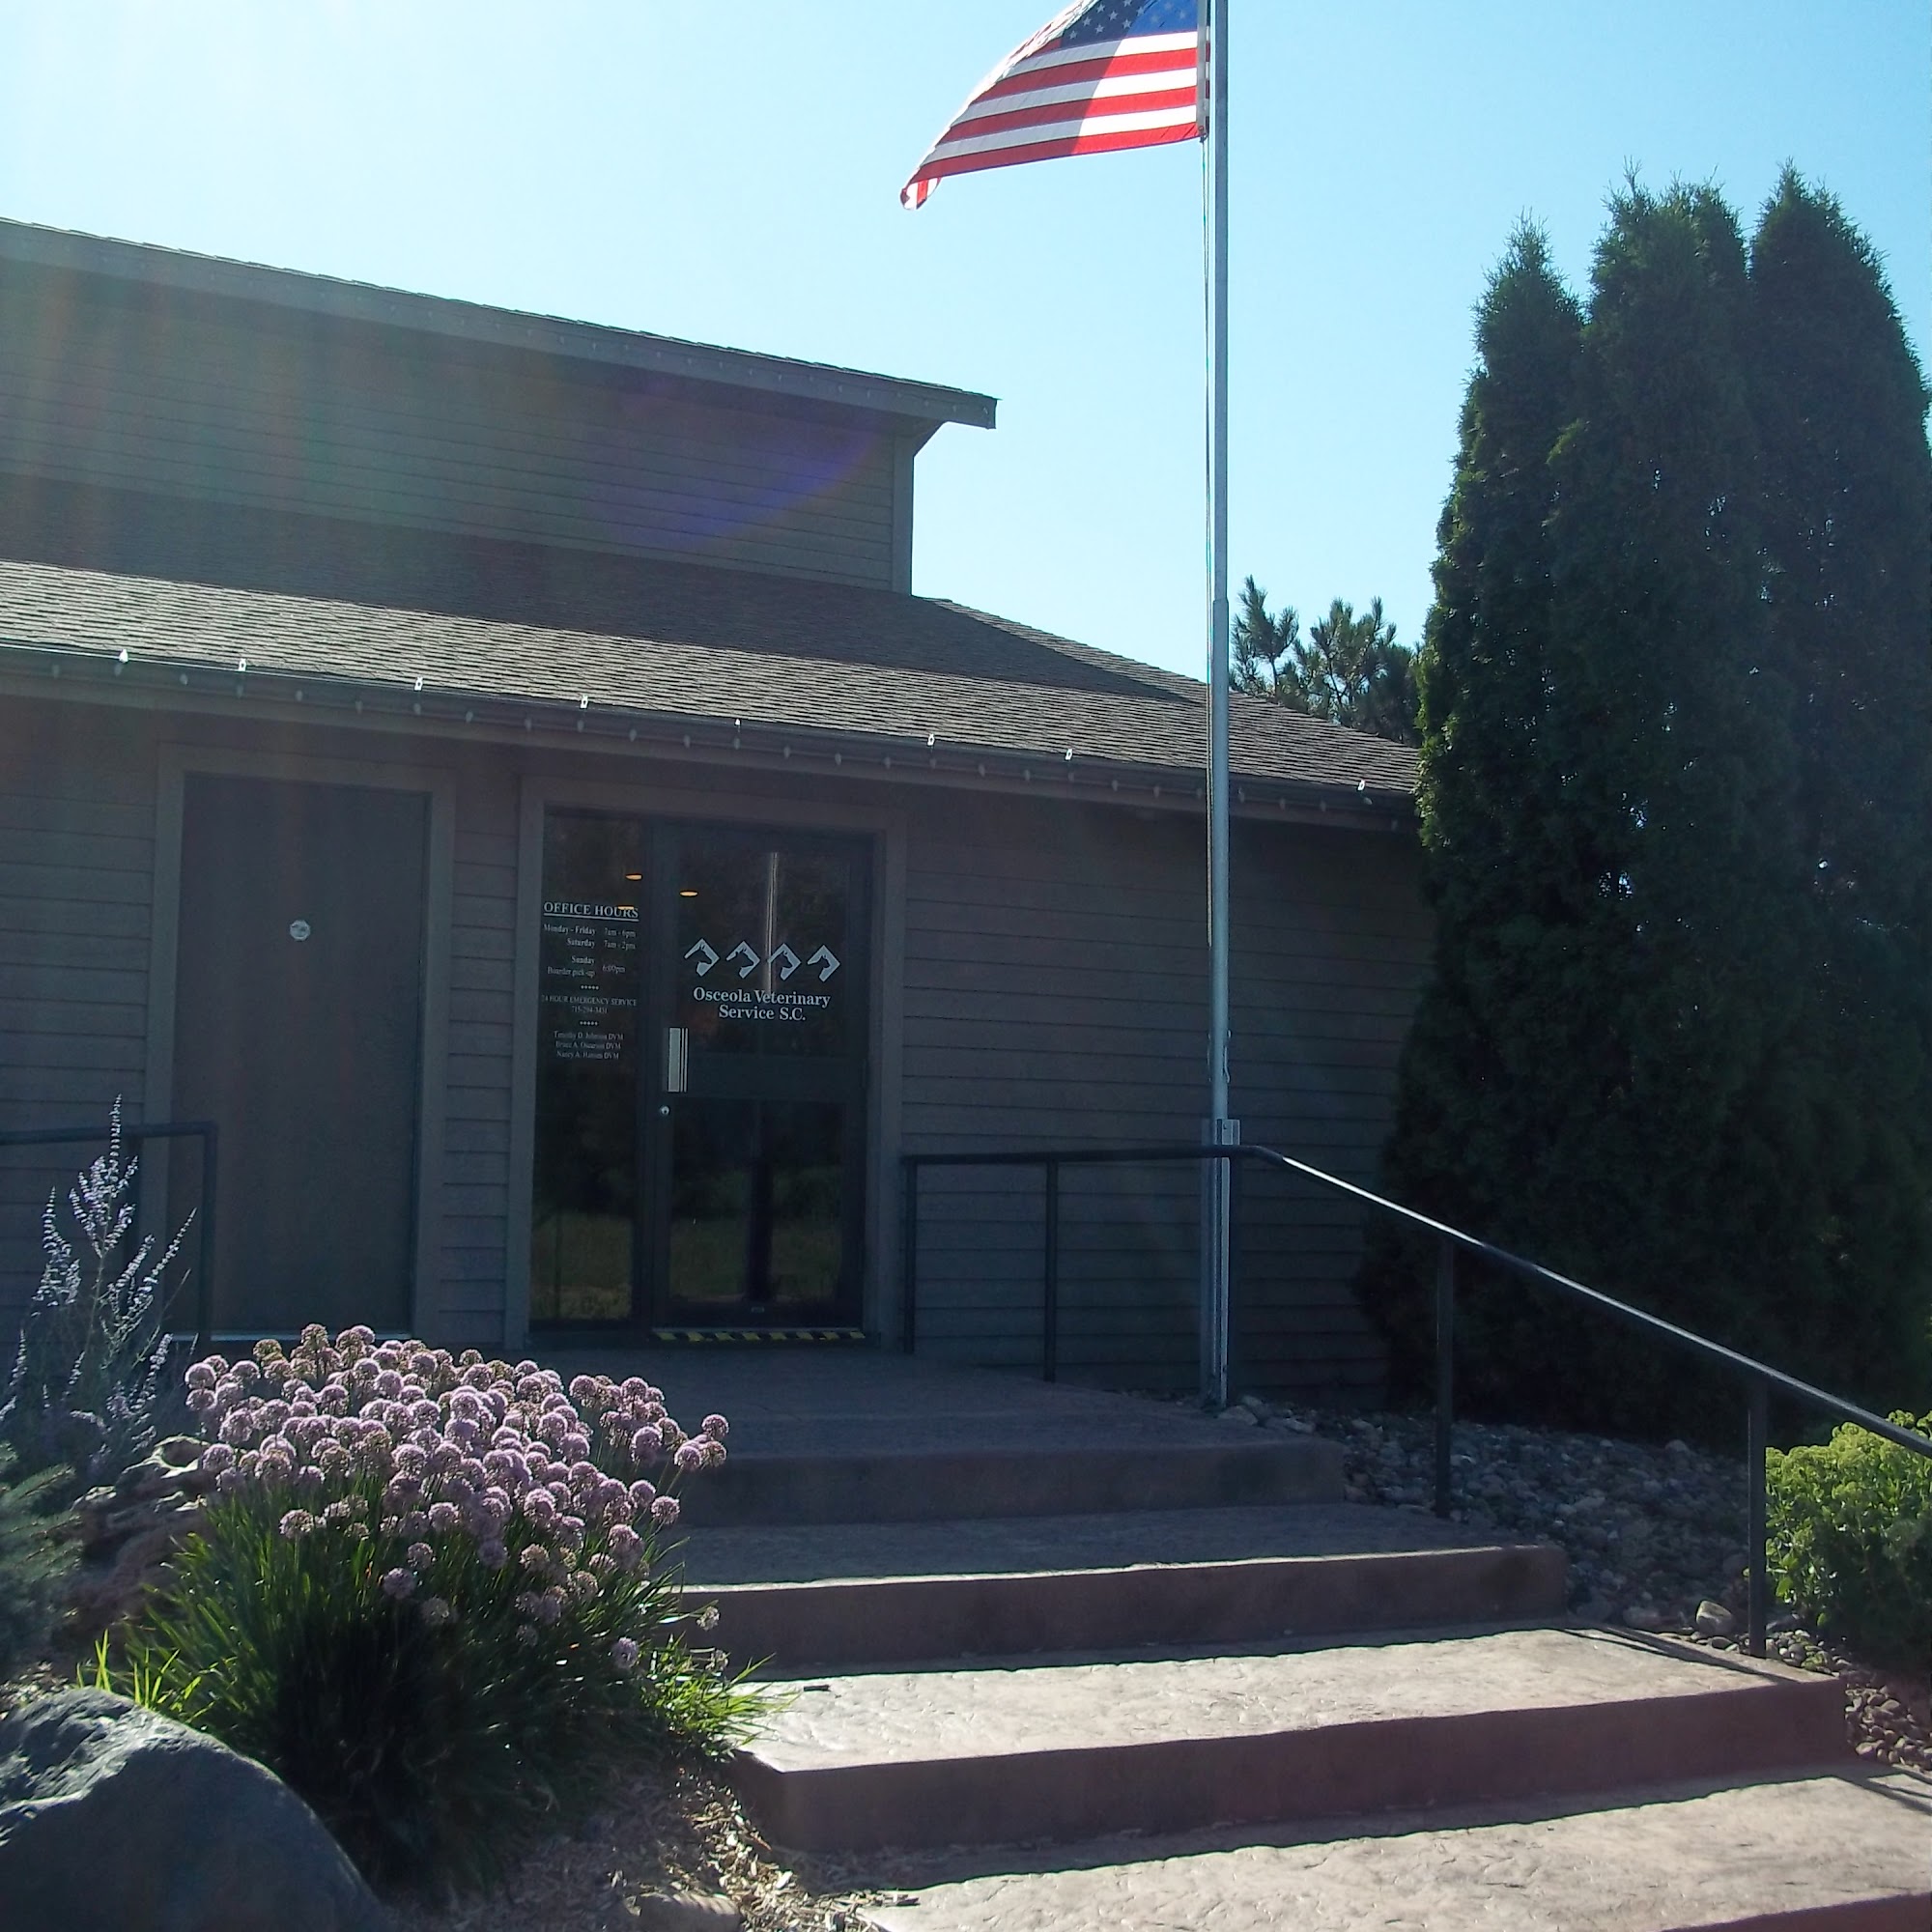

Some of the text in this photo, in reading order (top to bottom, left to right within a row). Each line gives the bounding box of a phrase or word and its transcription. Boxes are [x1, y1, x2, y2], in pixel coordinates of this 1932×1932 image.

[543, 901, 639, 919] OFFICE HOURS
[575, 925, 596, 936] Friday
[566, 937, 595, 949] Saturday
[571, 954, 595, 966] Sunday
[693, 986, 832, 1009] Osceola Veterinary
[719, 1004, 807, 1021] Service S.C.
